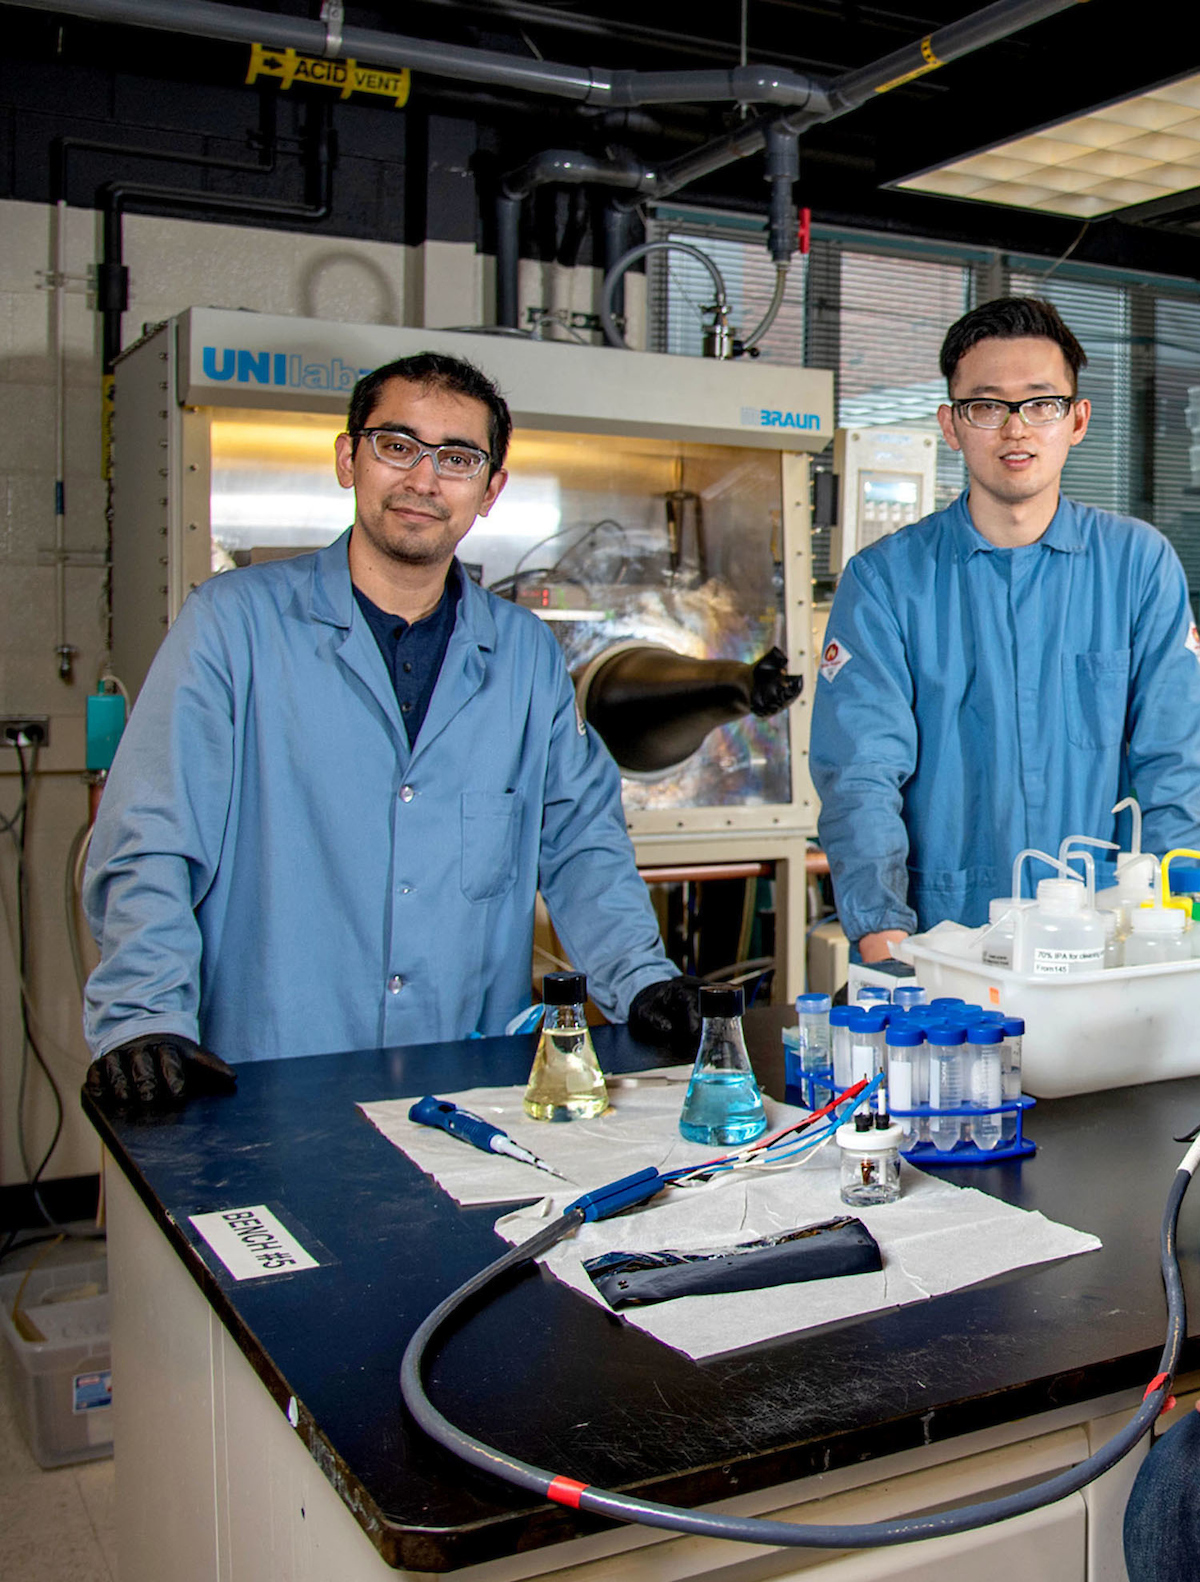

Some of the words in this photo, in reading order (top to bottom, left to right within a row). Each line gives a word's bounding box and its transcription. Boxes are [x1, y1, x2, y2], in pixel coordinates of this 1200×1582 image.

[294, 60, 347, 84] ACID
[354, 71, 401, 92] VENT
[1037, 951, 1053, 959] 70%
[1054, 952, 1067, 960] IPA
[221, 1211, 282, 1252] BENCH
[255, 1252, 297, 1269] #5
